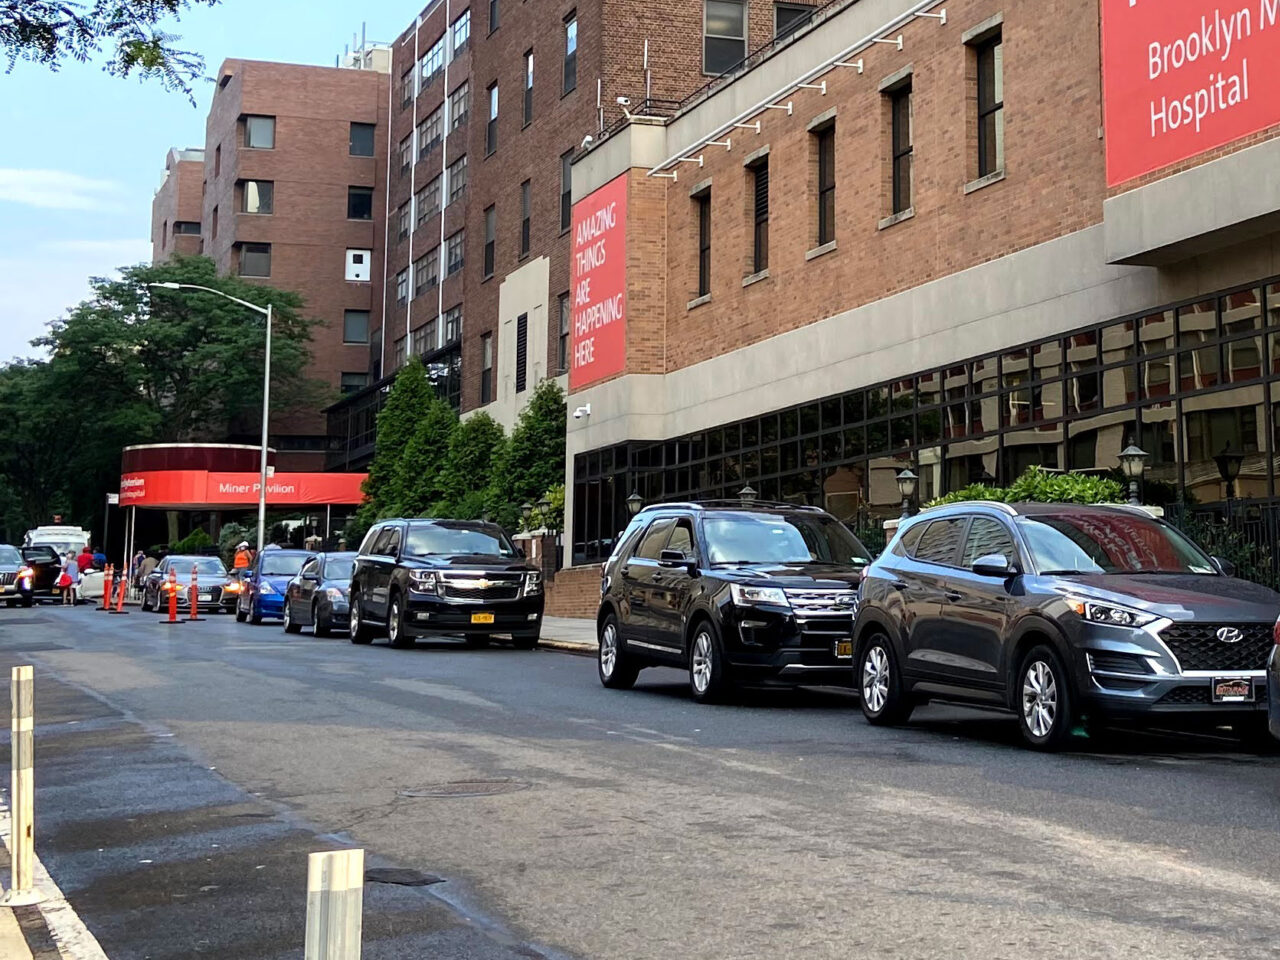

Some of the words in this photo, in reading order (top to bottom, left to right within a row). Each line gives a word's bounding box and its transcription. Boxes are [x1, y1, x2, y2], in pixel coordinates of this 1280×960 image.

[1148, 7, 1251, 81] Brooklyn
[1149, 57, 1249, 138] Hospital
[576, 201, 616, 248] AMAZING
[575, 238, 606, 277] THINGS
[575, 278, 591, 308] ARE
[574, 292, 623, 338] HAPPENING
[574, 336, 595, 369] HERE
[219, 482, 251, 494] Miner
[252, 482, 295, 494] Pvilion
